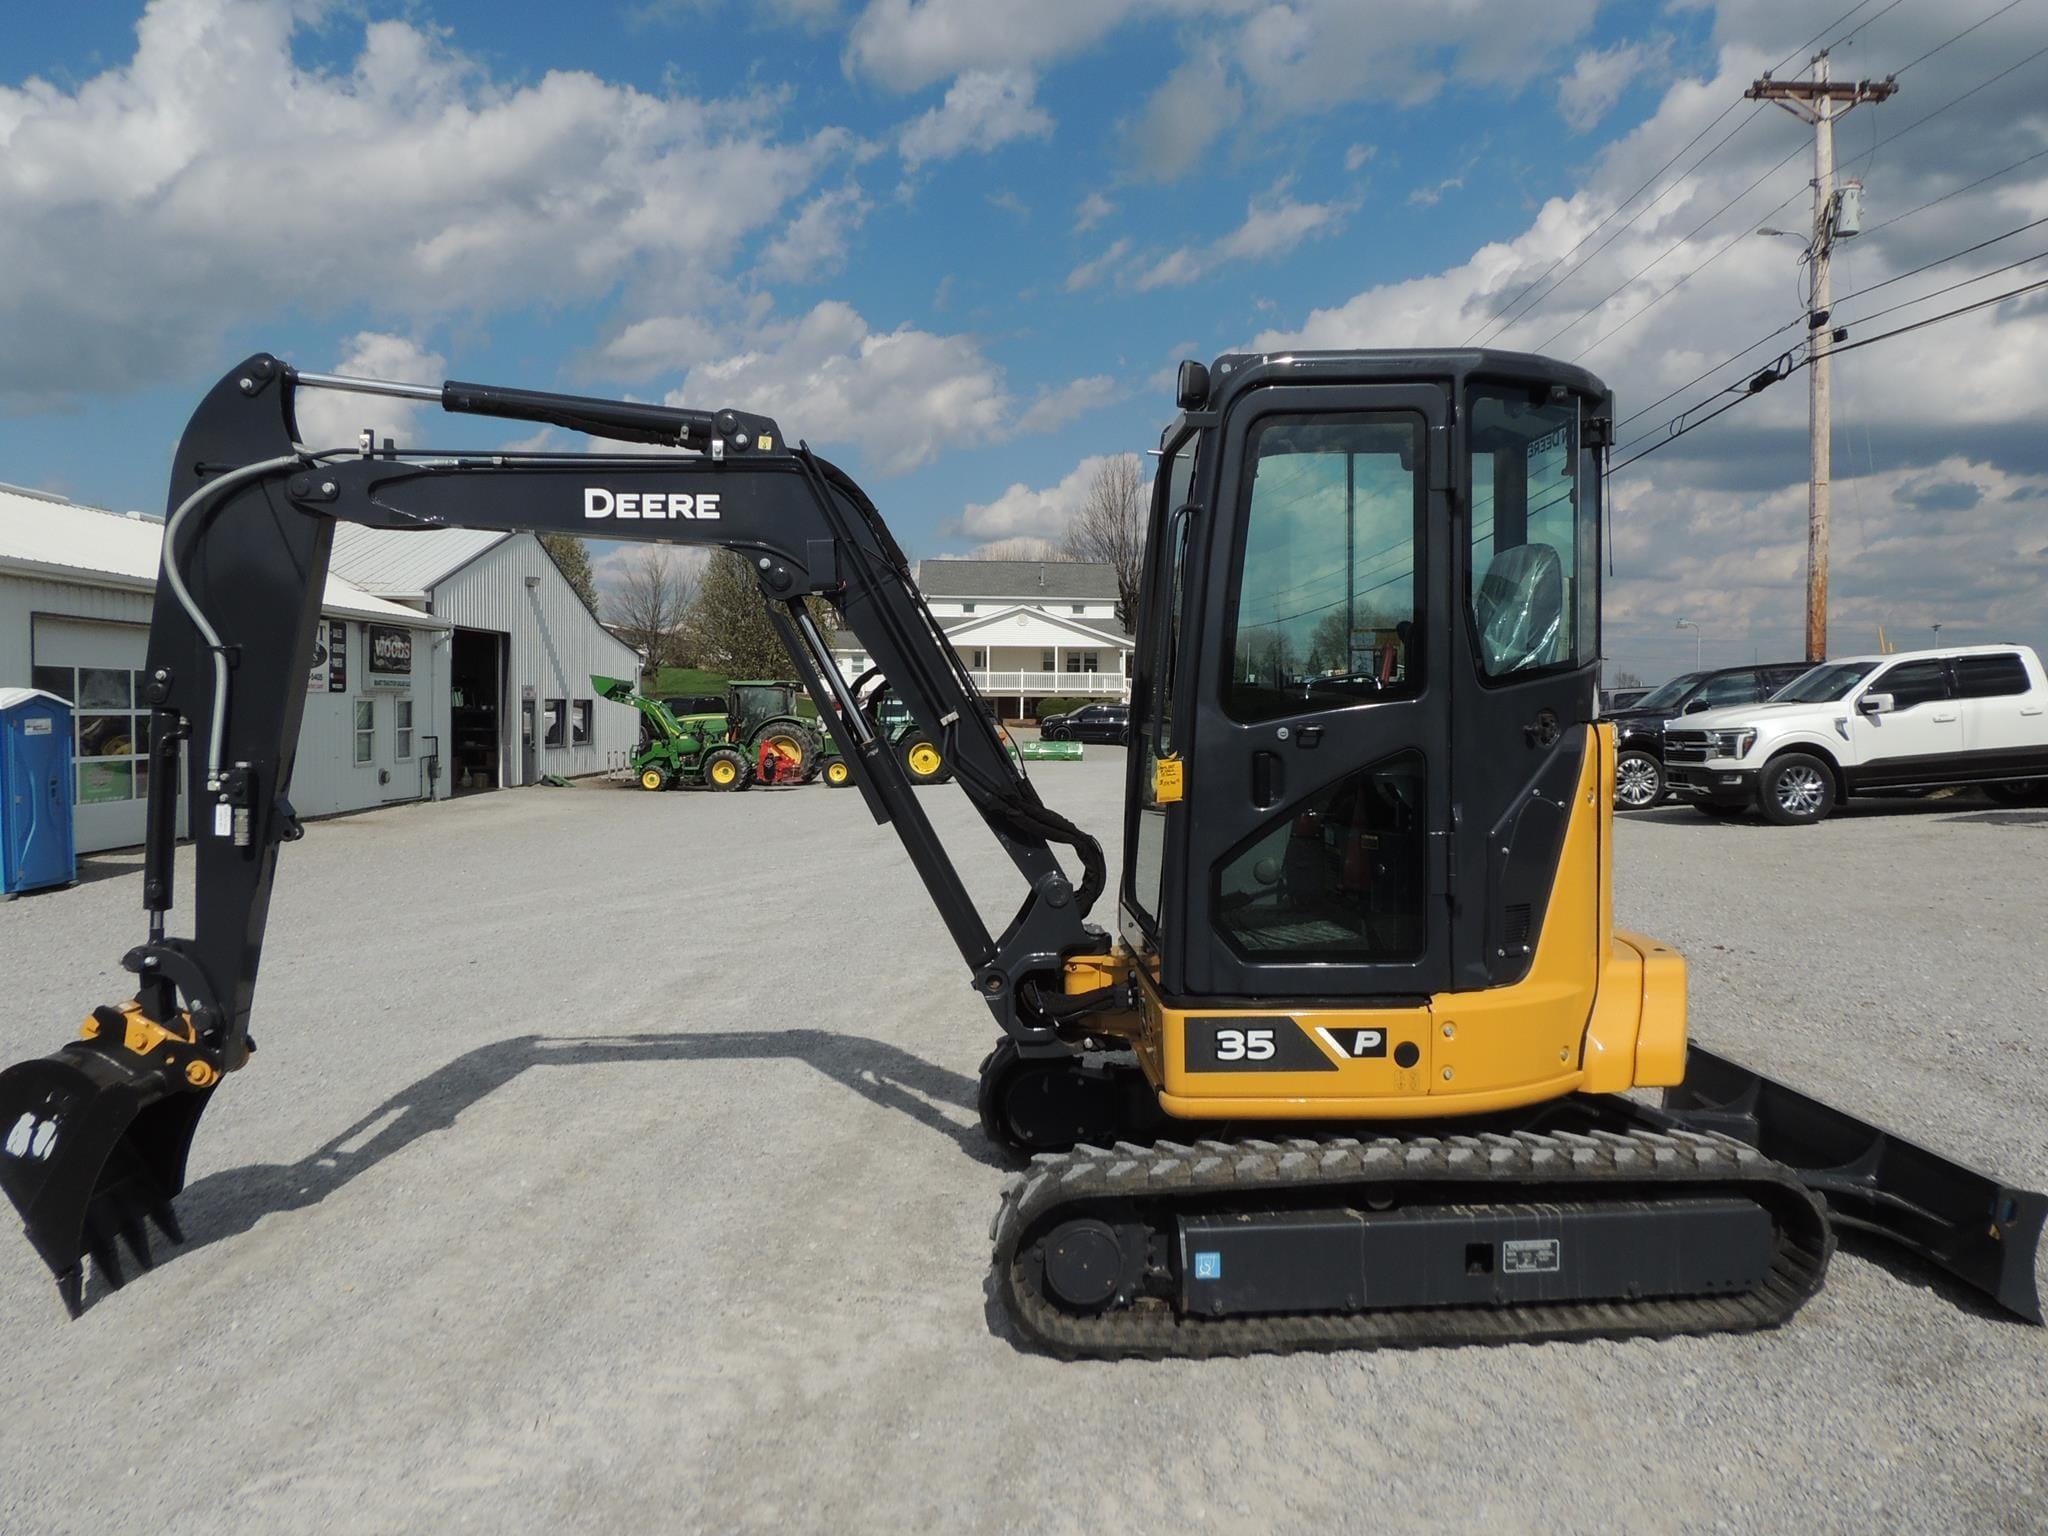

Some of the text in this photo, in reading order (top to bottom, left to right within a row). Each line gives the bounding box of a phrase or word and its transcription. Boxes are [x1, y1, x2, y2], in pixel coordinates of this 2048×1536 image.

[584, 488, 721, 519] DEERE
[375, 636, 410, 659] WOODS
[1216, 1029, 1382, 1061] 35 P
